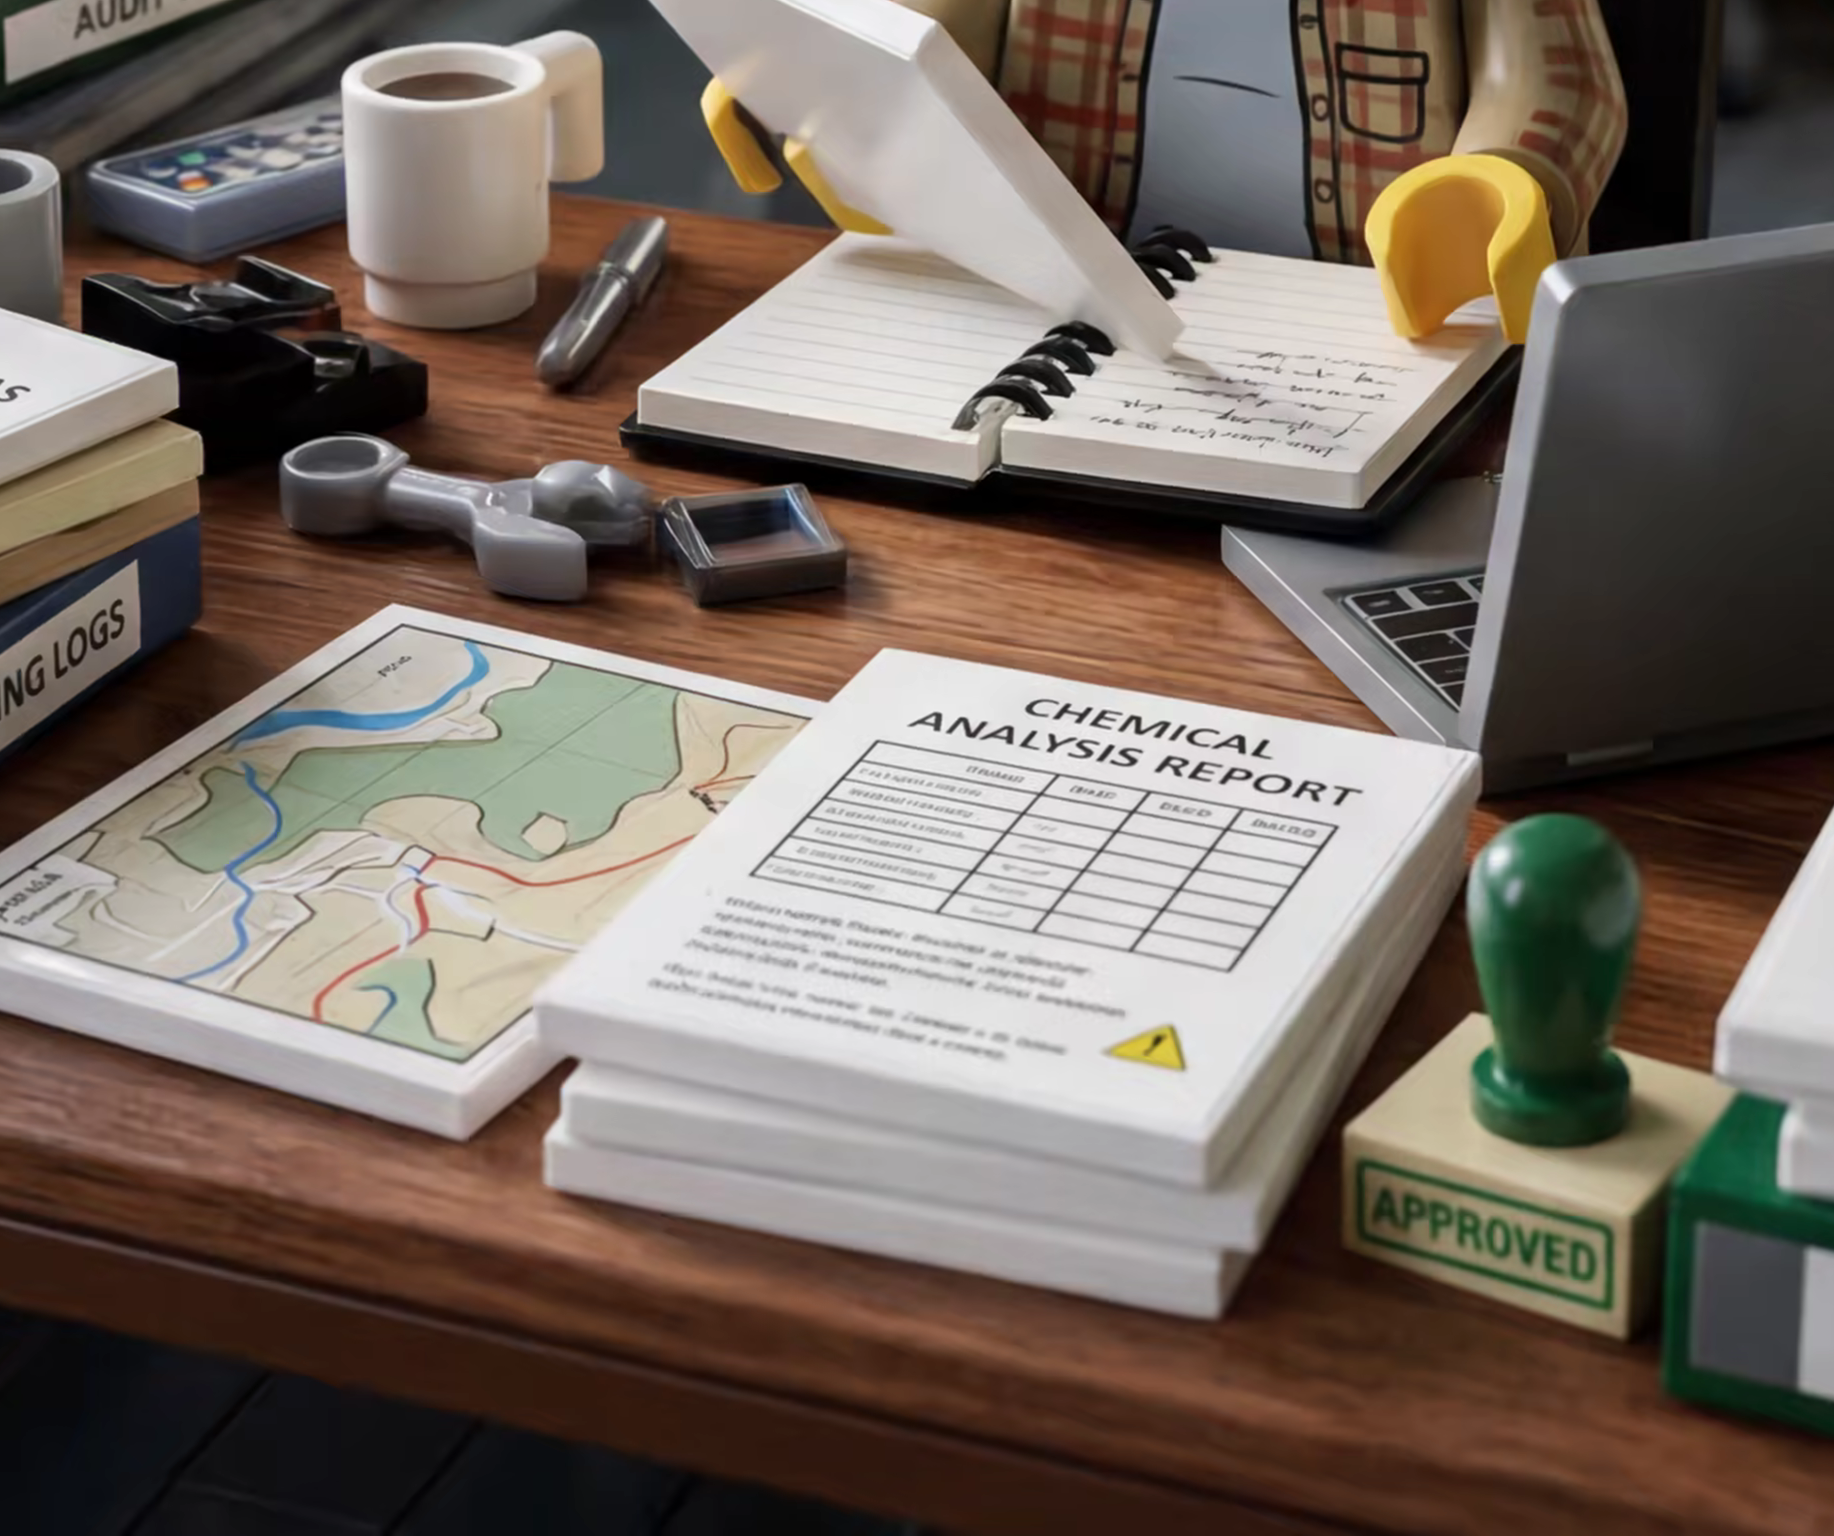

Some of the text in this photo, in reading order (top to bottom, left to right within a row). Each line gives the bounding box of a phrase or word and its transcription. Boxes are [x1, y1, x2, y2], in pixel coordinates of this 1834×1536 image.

[52, 598, 125, 680] LOGS
[907, 710, 1364, 808] ANALYSIS REPORT
[1024, 698, 1275, 760] CHEMICAL
[1371, 1186, 1598, 1283] APPROVED
